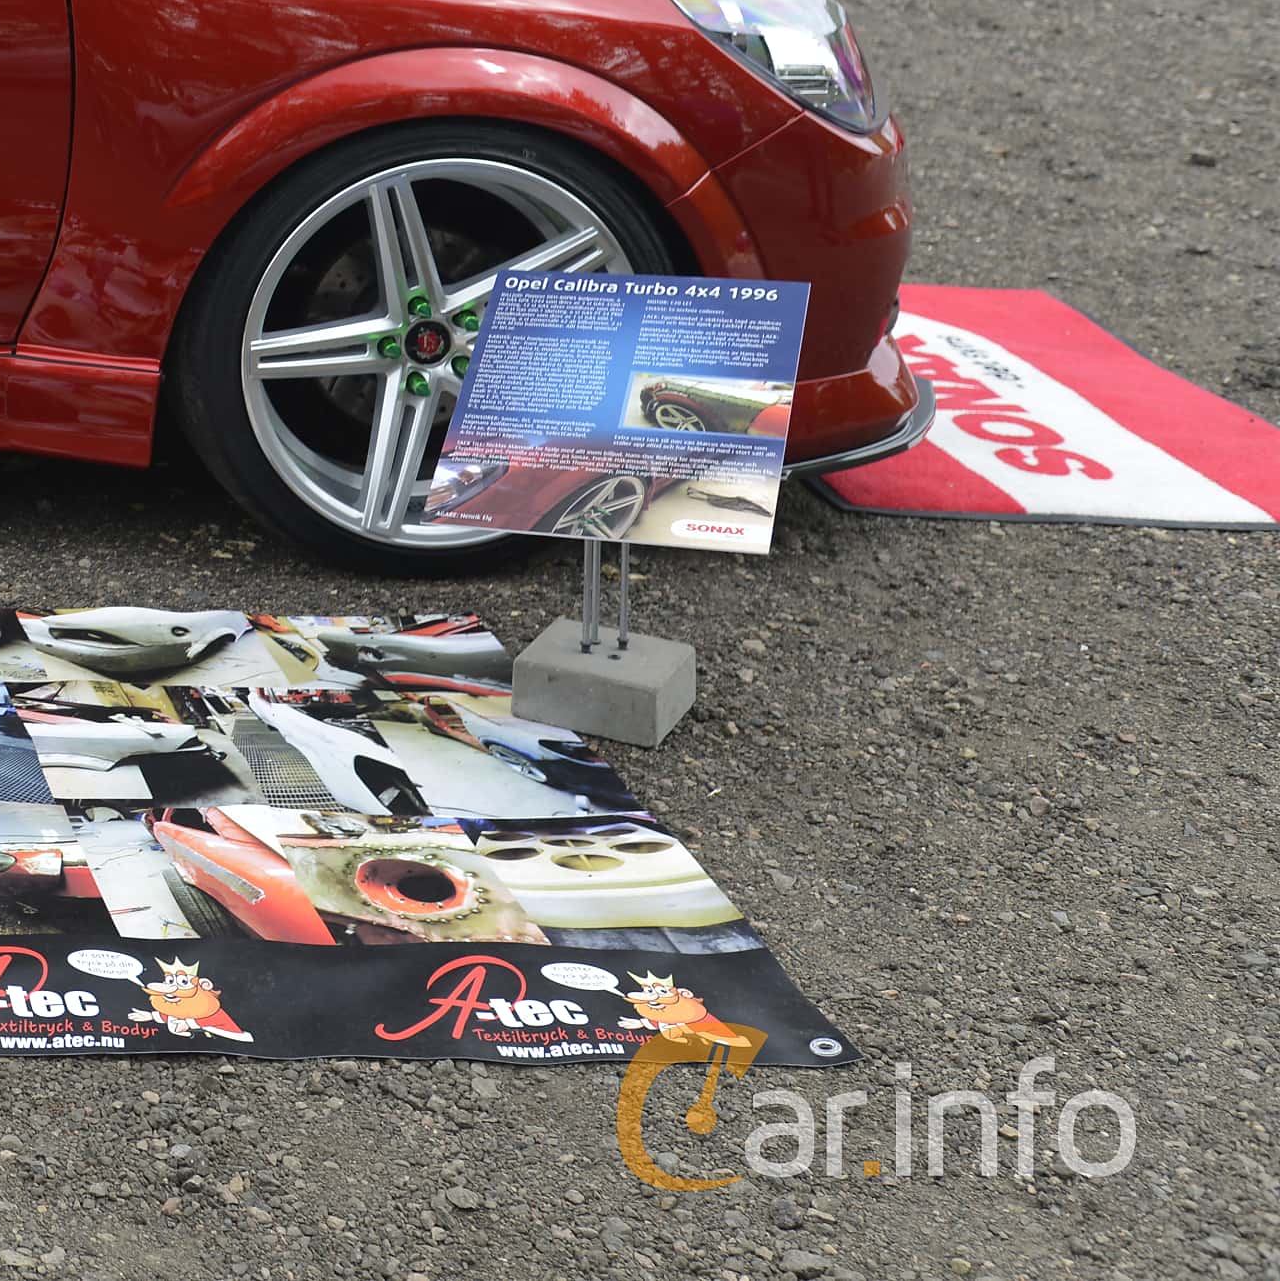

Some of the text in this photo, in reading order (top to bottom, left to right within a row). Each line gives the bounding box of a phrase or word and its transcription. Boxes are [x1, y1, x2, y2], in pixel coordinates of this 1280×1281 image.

[504, 275, 779, 303] Opel Calibra Turbo 4x4 1996
[686, 523, 746, 537] SONAX
[82, 1021, 93, 1033] &
[100, 1020, 160, 1039] Brodyr
[471, 1027, 569, 1046] Textiltryck
[577, 1030, 589, 1040] &
[0, 1032, 126, 1050] www.atec.nu
[496, 1042, 625, 1059] www.atec.nu
